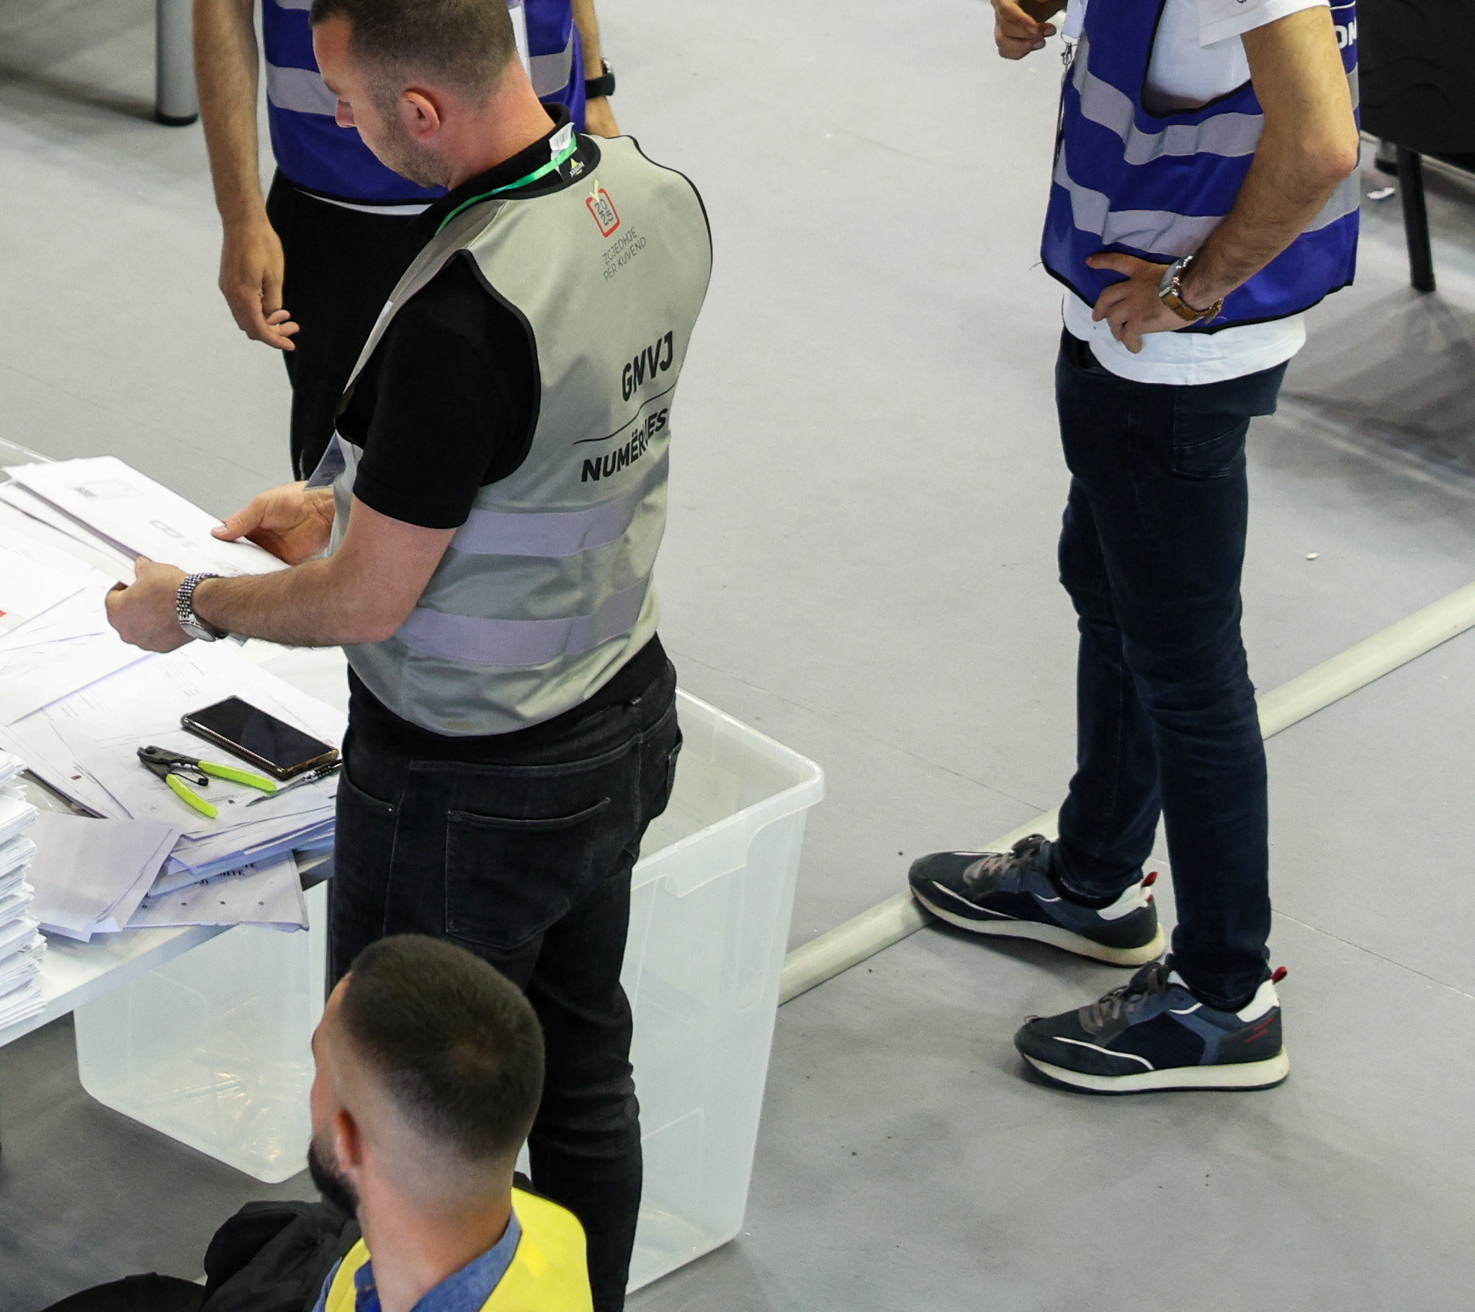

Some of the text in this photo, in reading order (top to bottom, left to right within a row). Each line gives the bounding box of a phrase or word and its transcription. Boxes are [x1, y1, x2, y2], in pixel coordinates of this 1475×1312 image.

[594, 198, 608, 215] 20
[600, 210, 614, 226] 25
[617, 236, 648, 268] KUVEND
[621, 330, 674, 402] GNVJ
